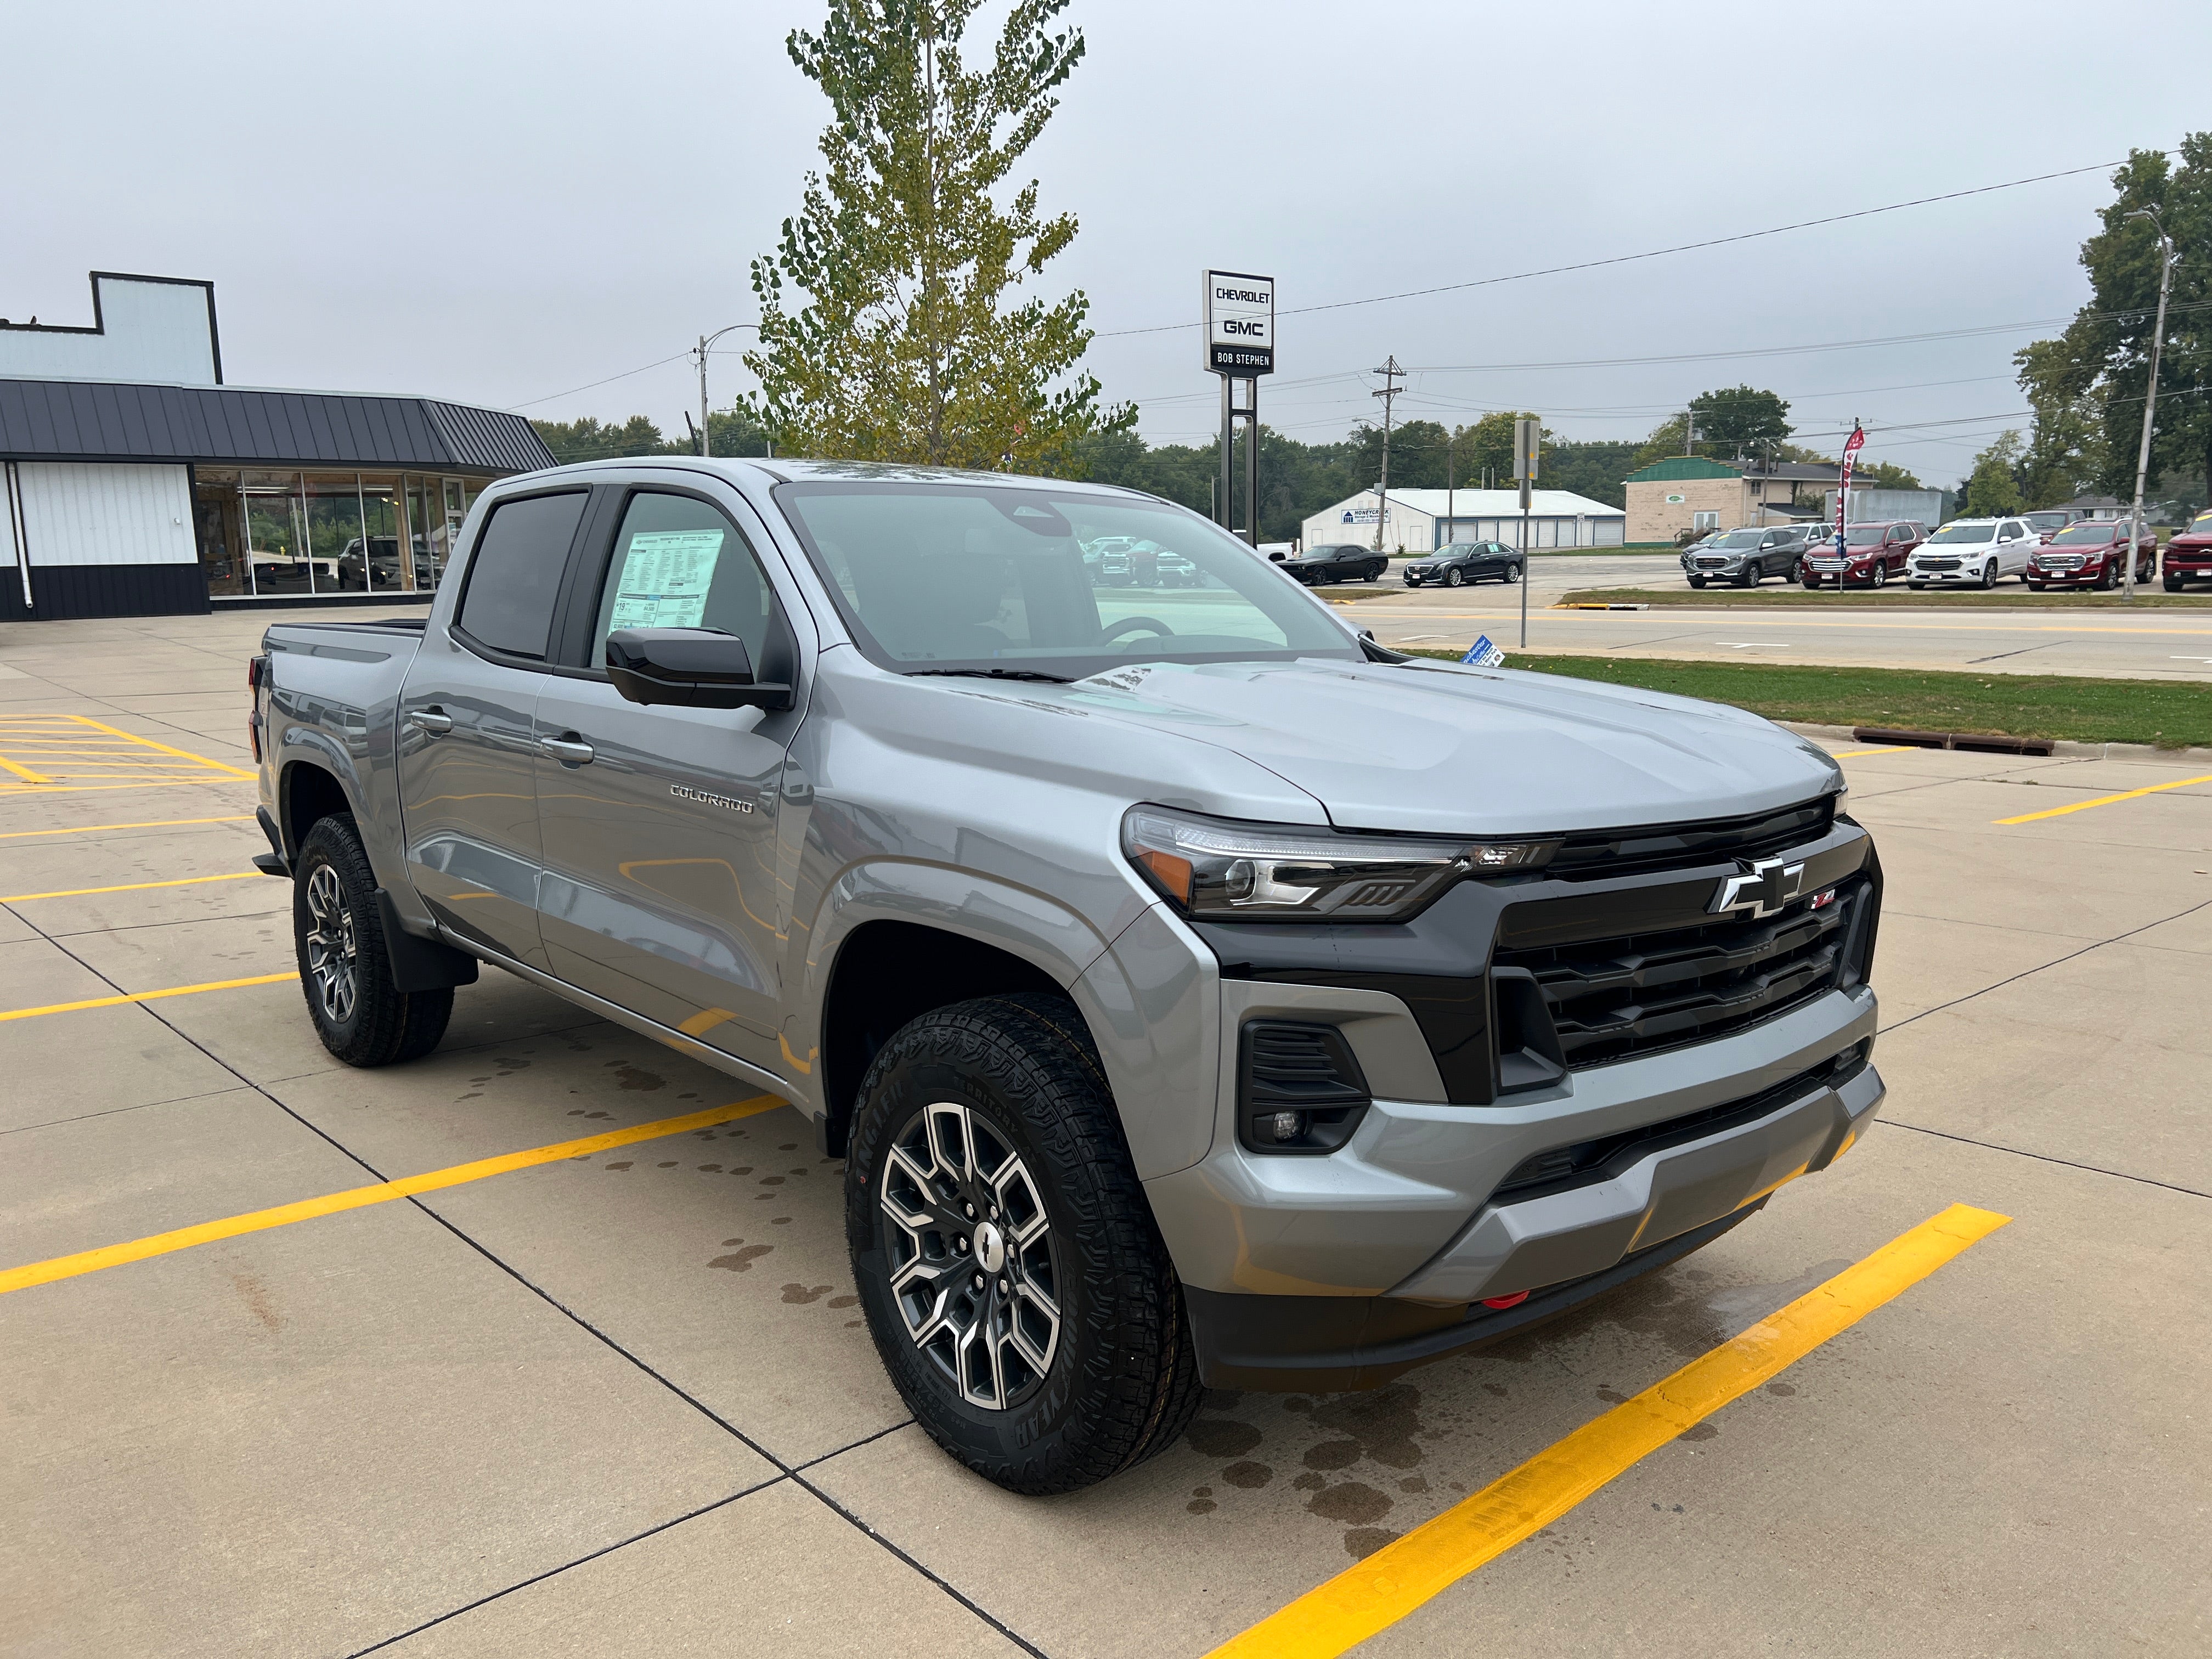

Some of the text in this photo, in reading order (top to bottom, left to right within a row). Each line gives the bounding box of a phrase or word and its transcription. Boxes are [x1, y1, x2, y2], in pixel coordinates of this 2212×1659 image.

[1216, 288, 1269, 303] CHEVROLET
[1224, 320, 1263, 336] GMC
[1217, 352, 1269, 366] BOB STEPHEN
[670, 785, 753, 814] COLORADO
